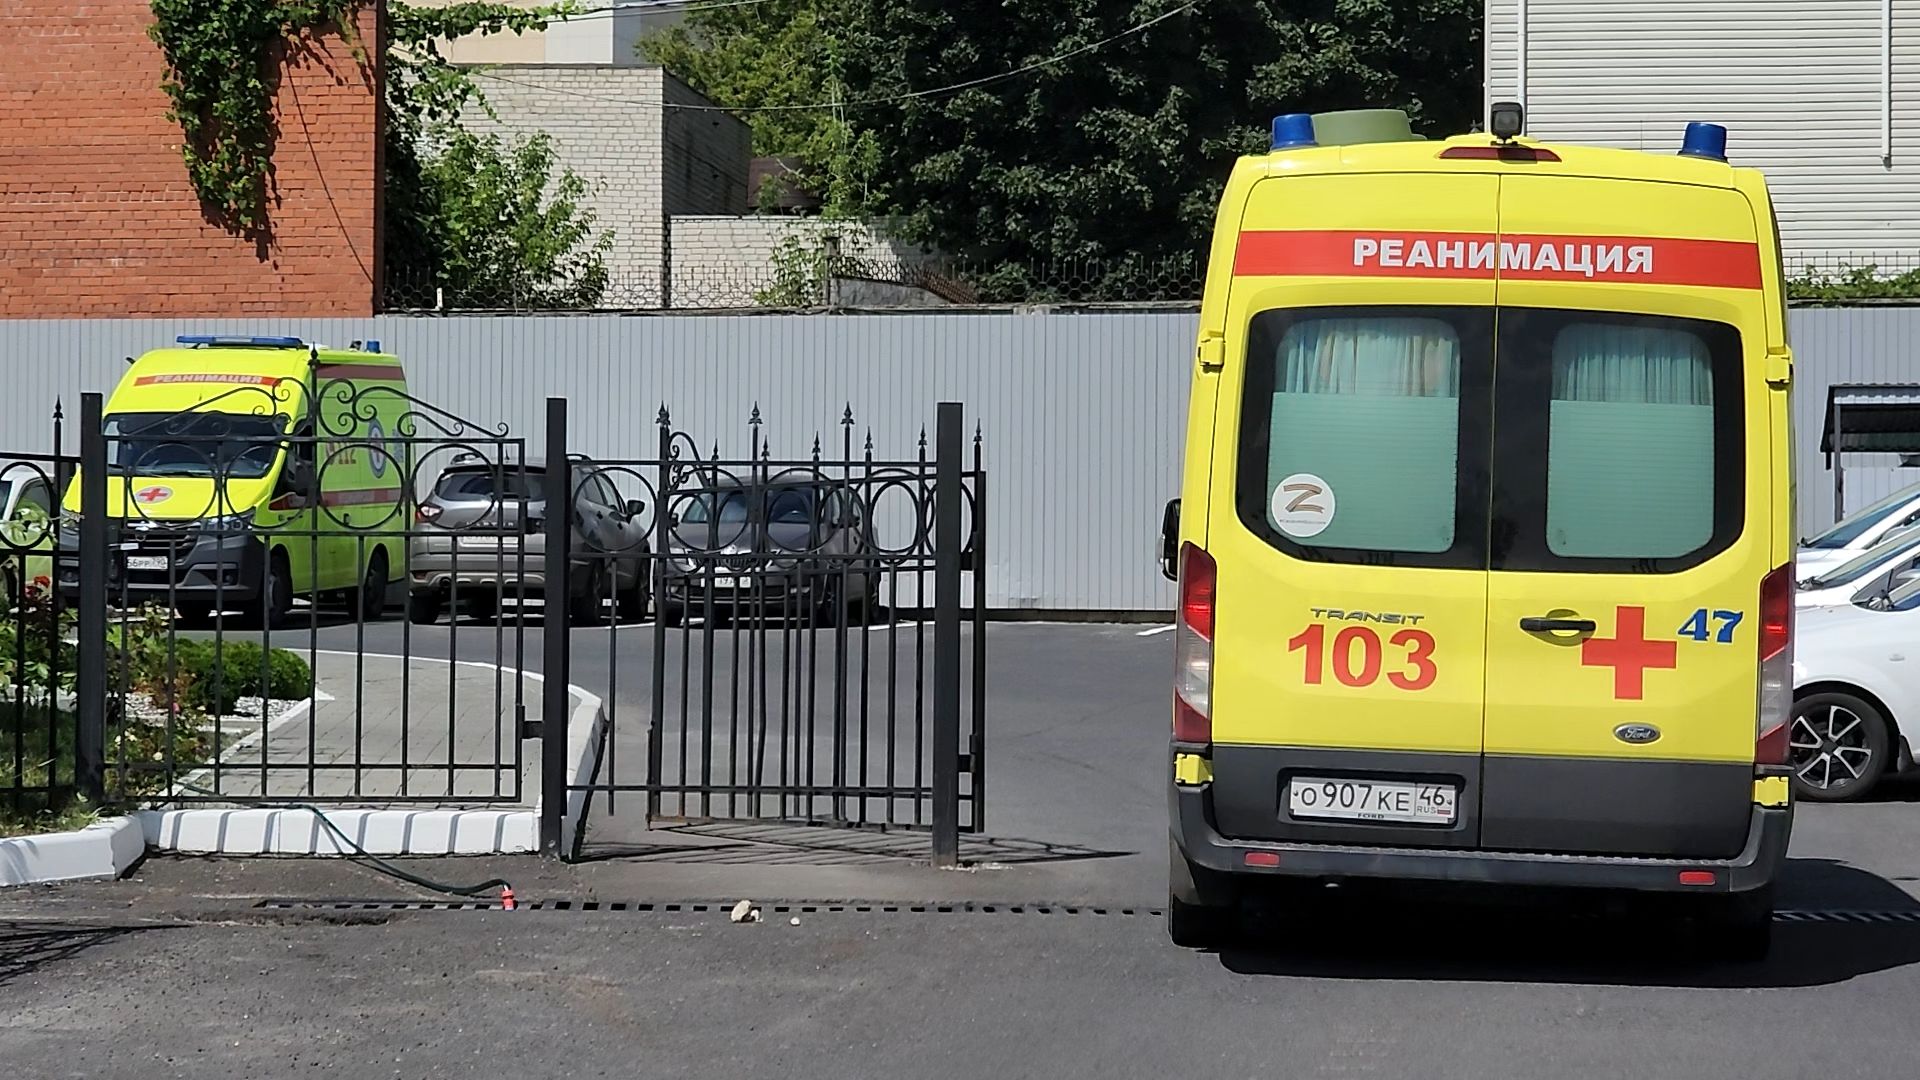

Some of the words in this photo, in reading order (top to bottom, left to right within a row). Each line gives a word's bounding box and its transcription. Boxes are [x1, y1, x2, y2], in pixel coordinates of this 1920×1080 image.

[1353, 239, 1653, 277] РЕАНИМАЦИЯ
[153, 374, 263, 384] РЕАНИМАЦИЯ
[1283, 483, 1325, 514] Z
[1310, 608, 1425, 625] TRANSIT
[1678, 608, 1743, 643] 47
[1288, 624, 1437, 691] 103
[1624, 727, 1651, 739] Ford
[1419, 786, 1445, 806] 46
[1416, 806, 1437, 814] RUS
